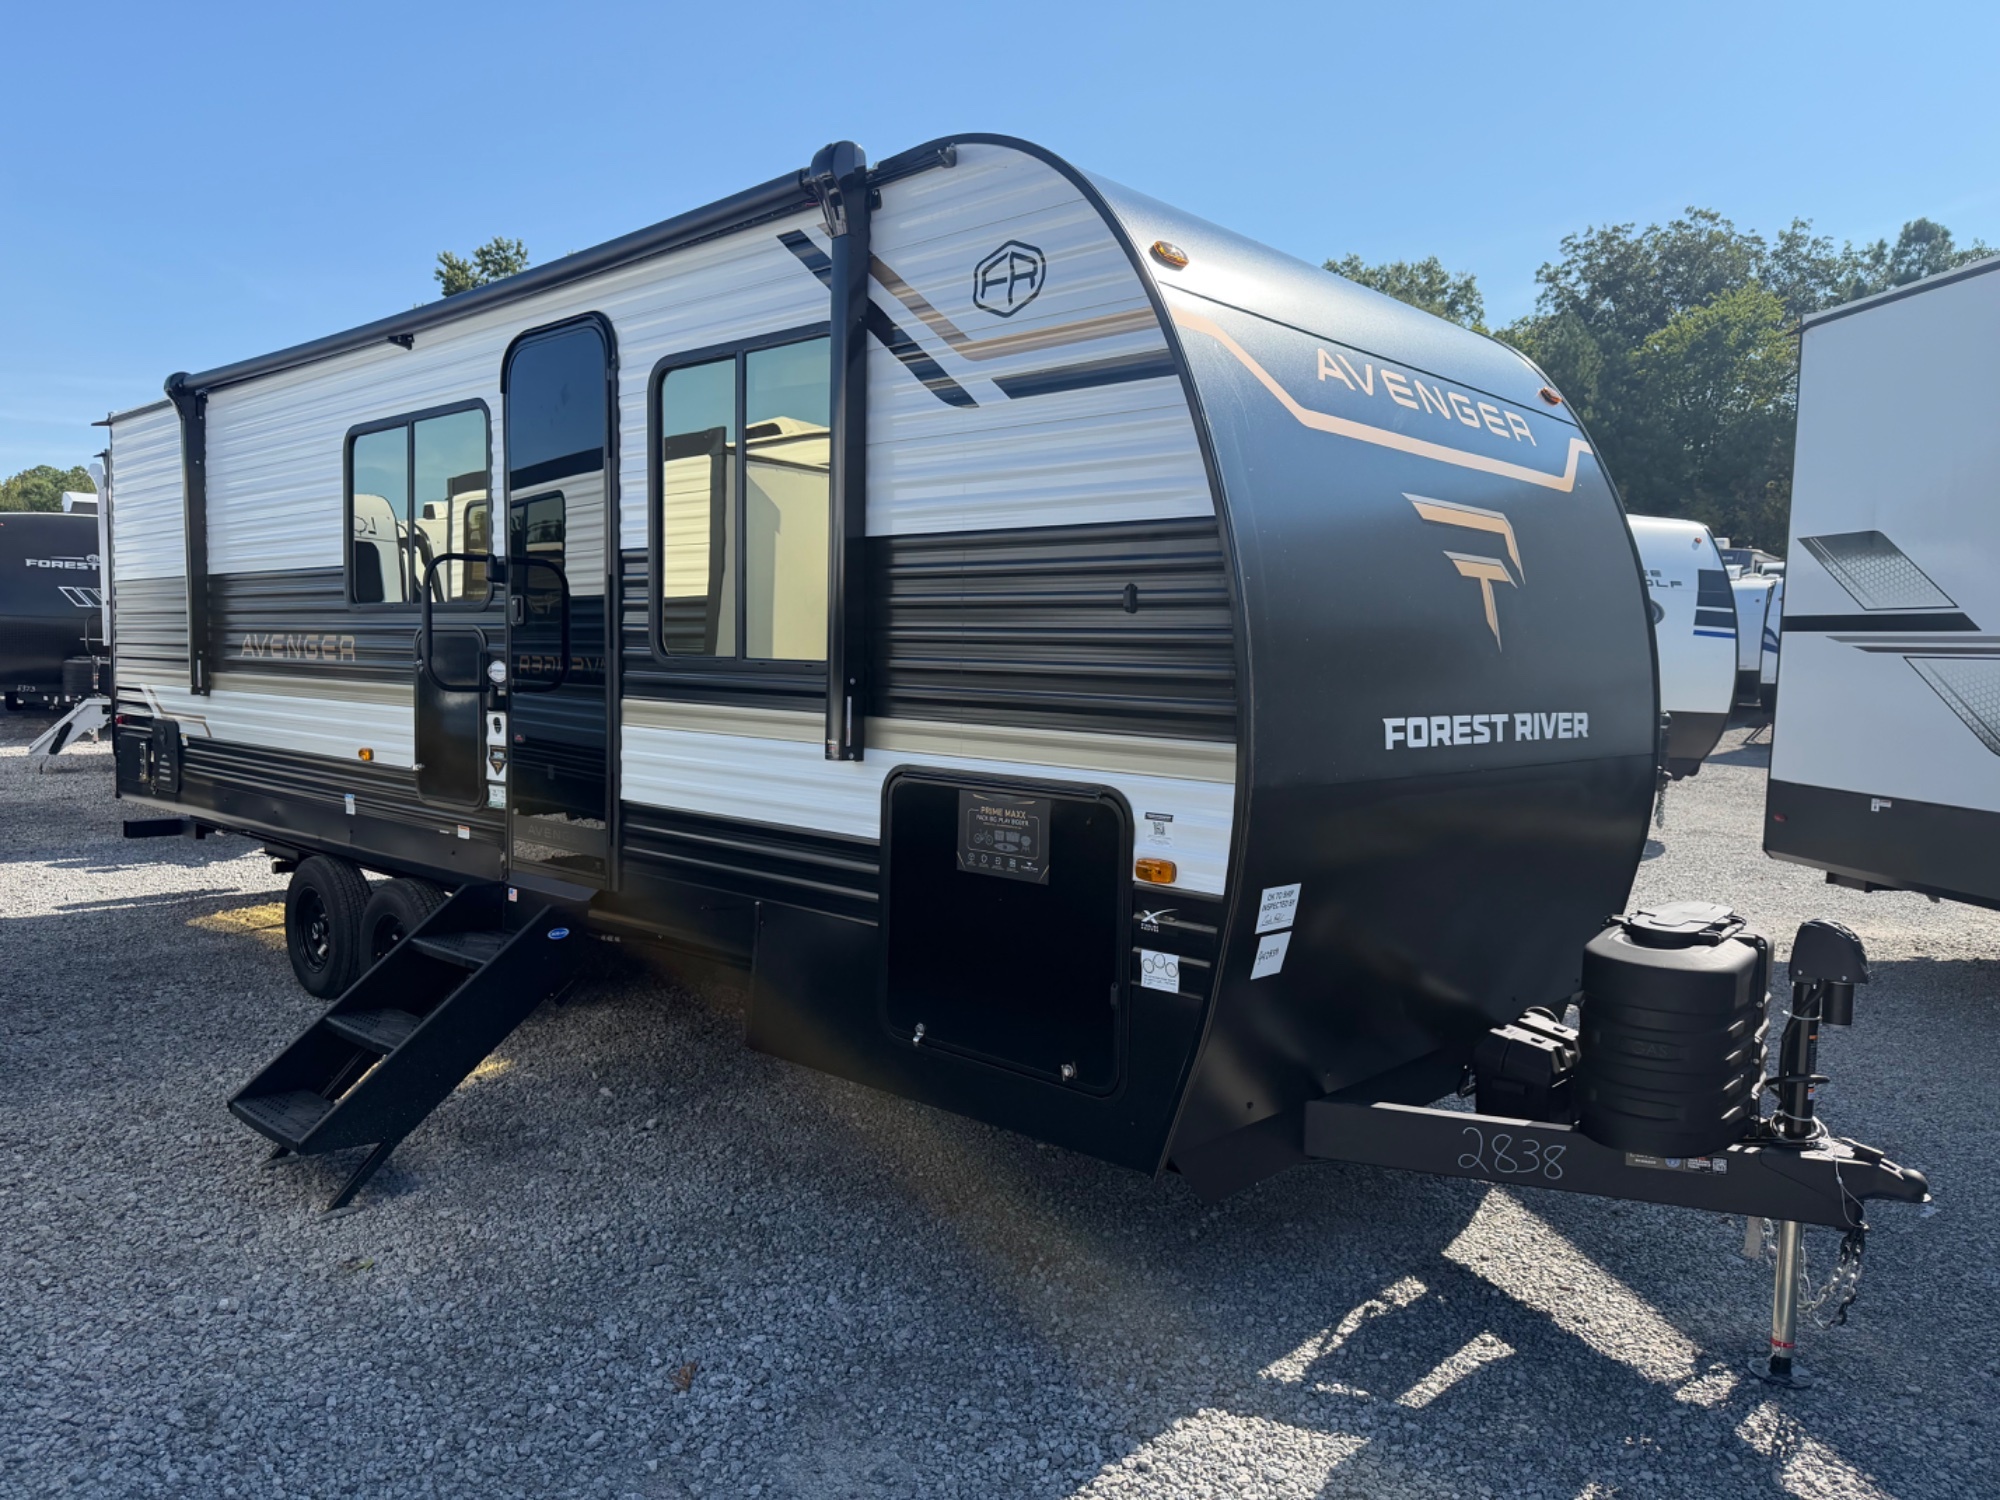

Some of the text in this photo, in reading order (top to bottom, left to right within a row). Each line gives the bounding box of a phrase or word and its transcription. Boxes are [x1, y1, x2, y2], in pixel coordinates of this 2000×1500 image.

[1317, 348, 1537, 447] AVENGER
[25, 558, 101, 571] FOREST
[1645, 579, 1683, 588] OLF
[240, 633, 356, 662] AVENGER
[1382, 712, 1589, 750] FOREST RIVER
[980, 806, 1027, 819] PRIME MAXX
[1267, 893, 1275, 902] OK
[1275, 891, 1283, 900] TO
[1261, 900, 1288, 913] INSPECTED
[1458, 1127, 1566, 1180] 2838
